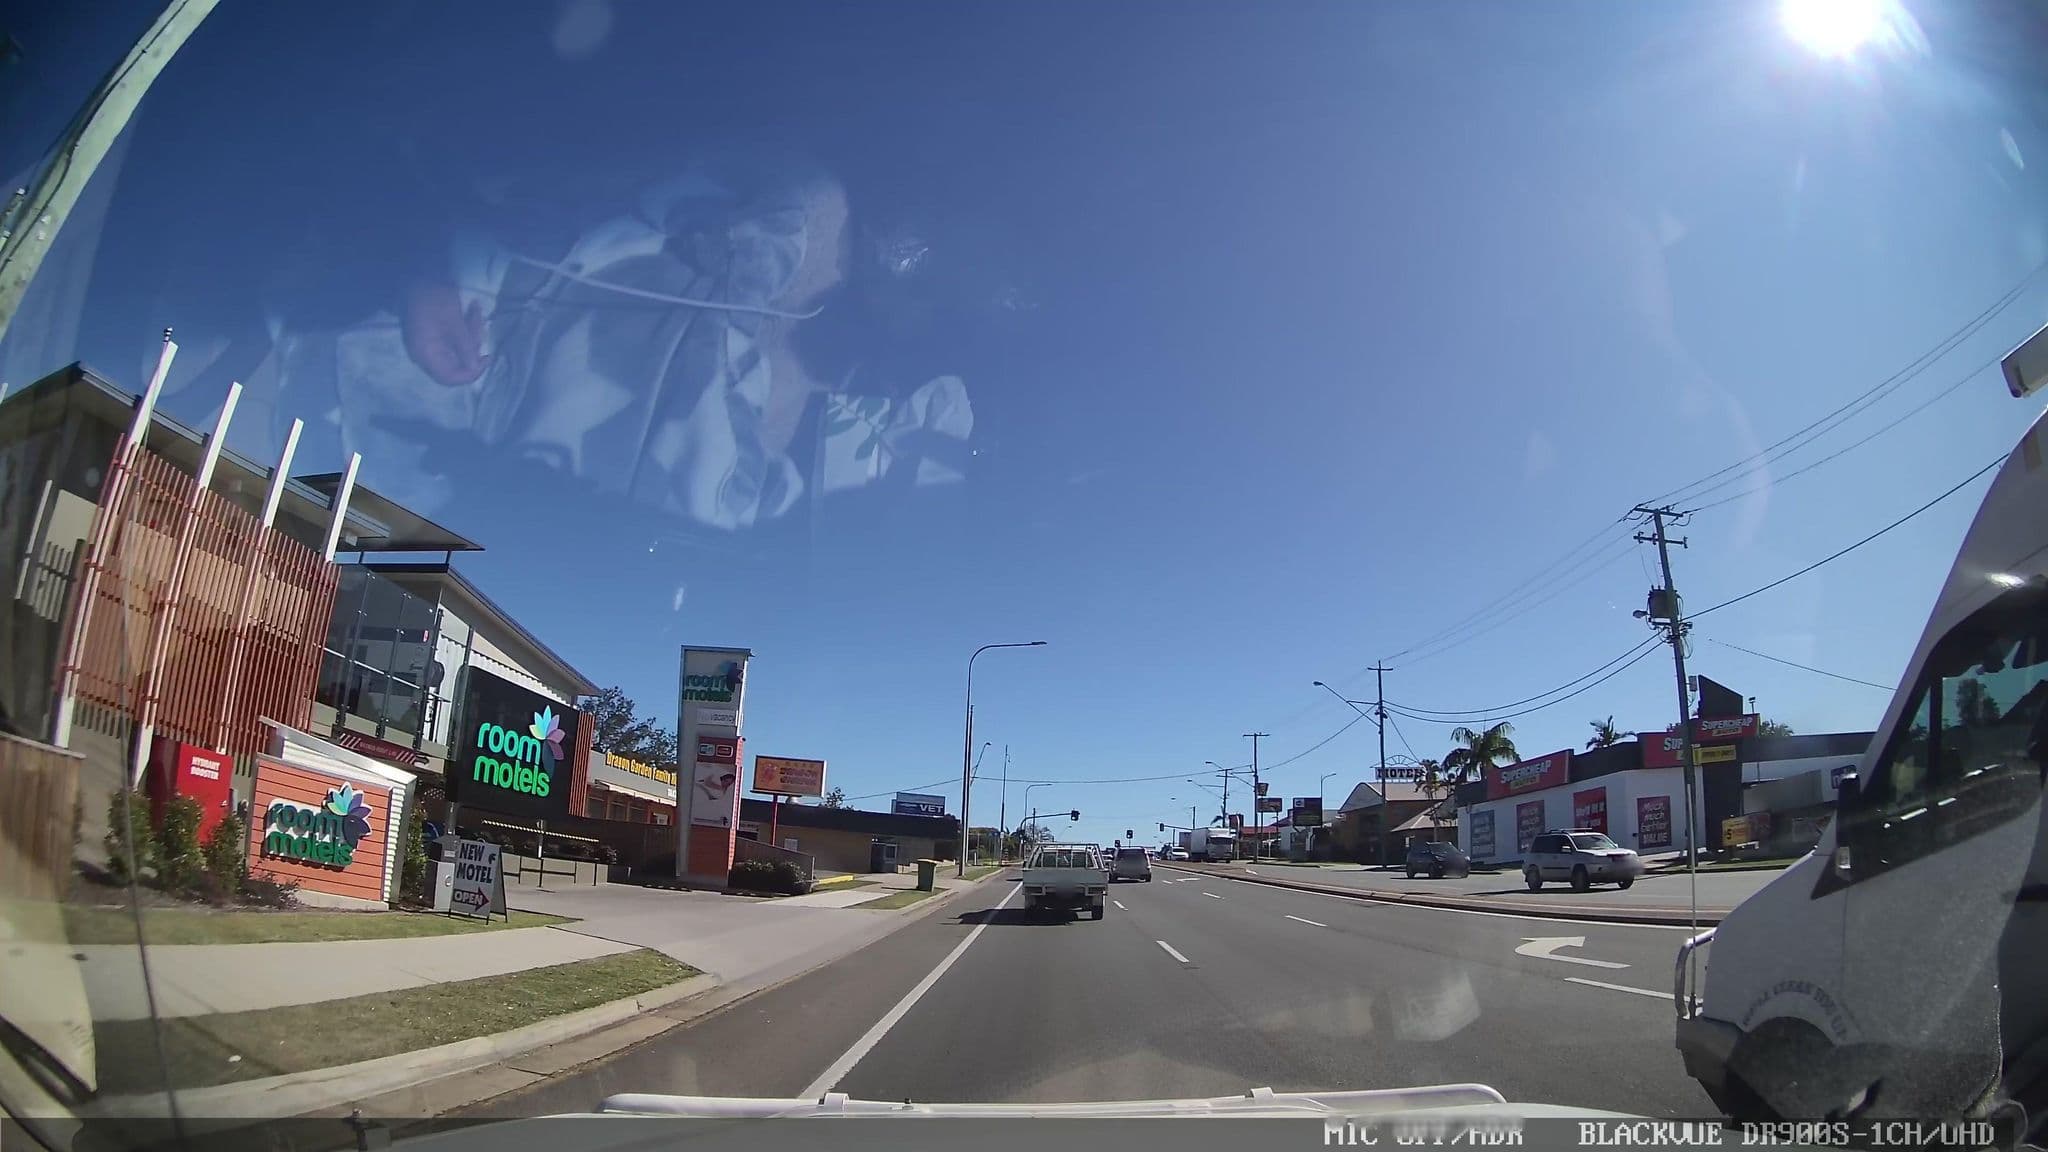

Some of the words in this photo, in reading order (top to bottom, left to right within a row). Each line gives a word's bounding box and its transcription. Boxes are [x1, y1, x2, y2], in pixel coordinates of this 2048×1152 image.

[477, 722, 541, 766] room
[473, 756, 550, 797] motels
[630, 759, 653, 780] Garden
[919, 804, 944, 813] VET
[265, 802, 344, 842] room
[262, 830, 353, 867] motels
[460, 843, 485, 861] NEW
[456, 862, 493, 884] MOTEL
[454, 890, 484, 906] OPEN
